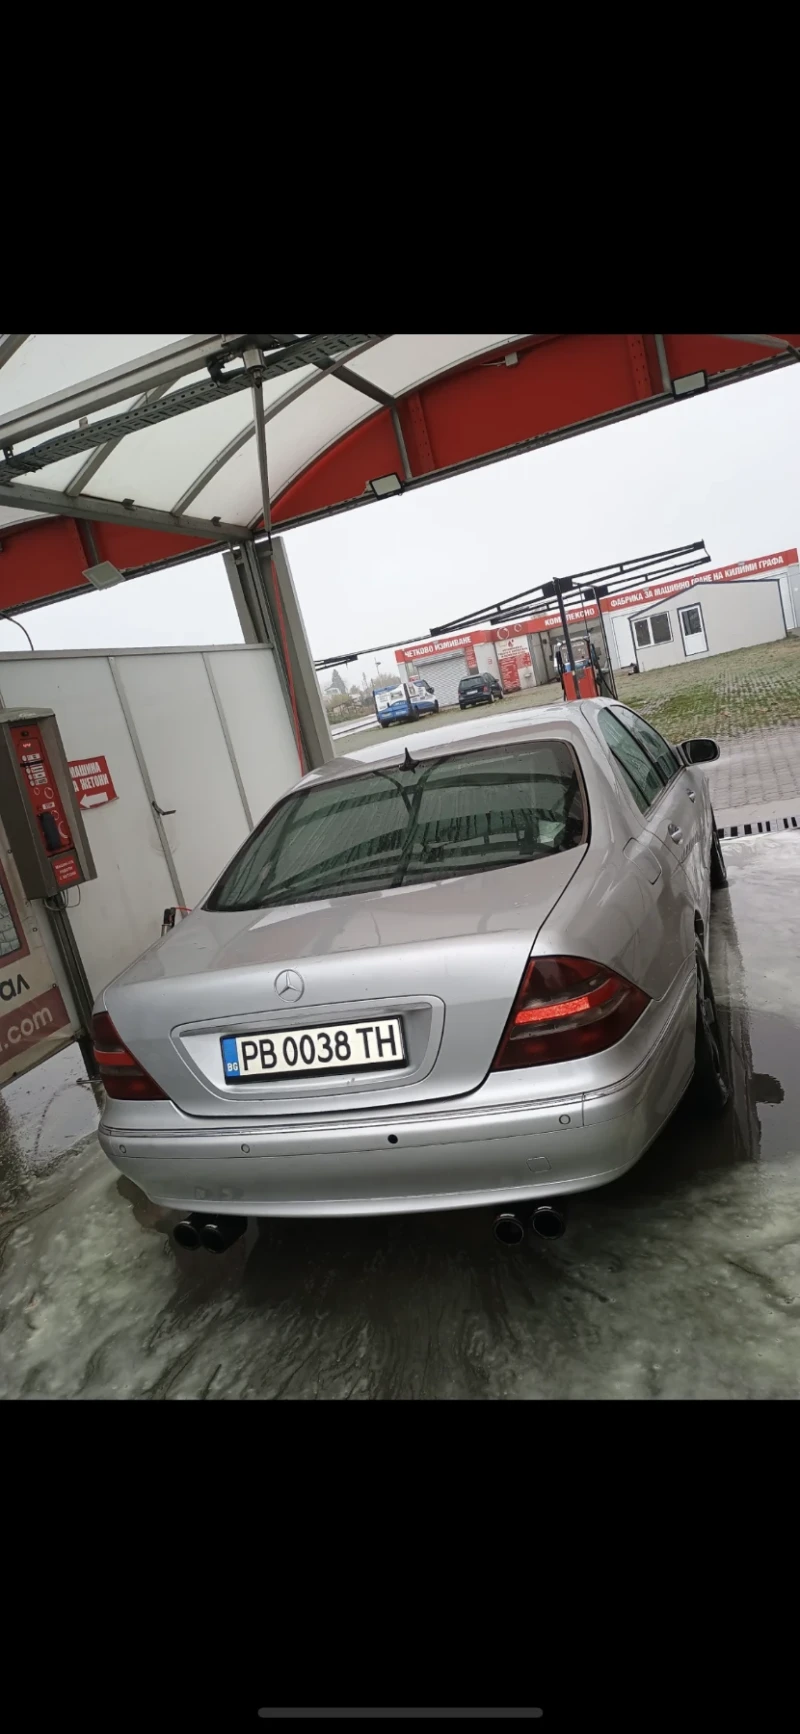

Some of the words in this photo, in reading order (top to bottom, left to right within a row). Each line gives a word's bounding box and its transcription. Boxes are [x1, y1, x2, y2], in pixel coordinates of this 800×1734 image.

[610, 593, 643, 608] ФАБРИКА
[644, 590, 653, 599] ЗА
[654, 580, 690, 596] МАШИННО
[713, 571, 724, 581] НА
[724, 562, 758, 578] КИЛИМИ
[758, 556, 784, 569] ГРАФА
[544, 608, 595, 626] КОМЛЕКСНО
[404, 646, 434, 658] ЧЕТКОВО
[434, 636, 472, 651] ИЗМИВАНЕ
[79, 773, 110, 791] ЖЕТОНИ
[0, 1007, 53, 1053] .com
[240, 1038, 278, 1072] PB
[282, 1030, 352, 1067] 0038
[355, 1024, 398, 1059] TH
[227, 1063, 239, 1072] BG
